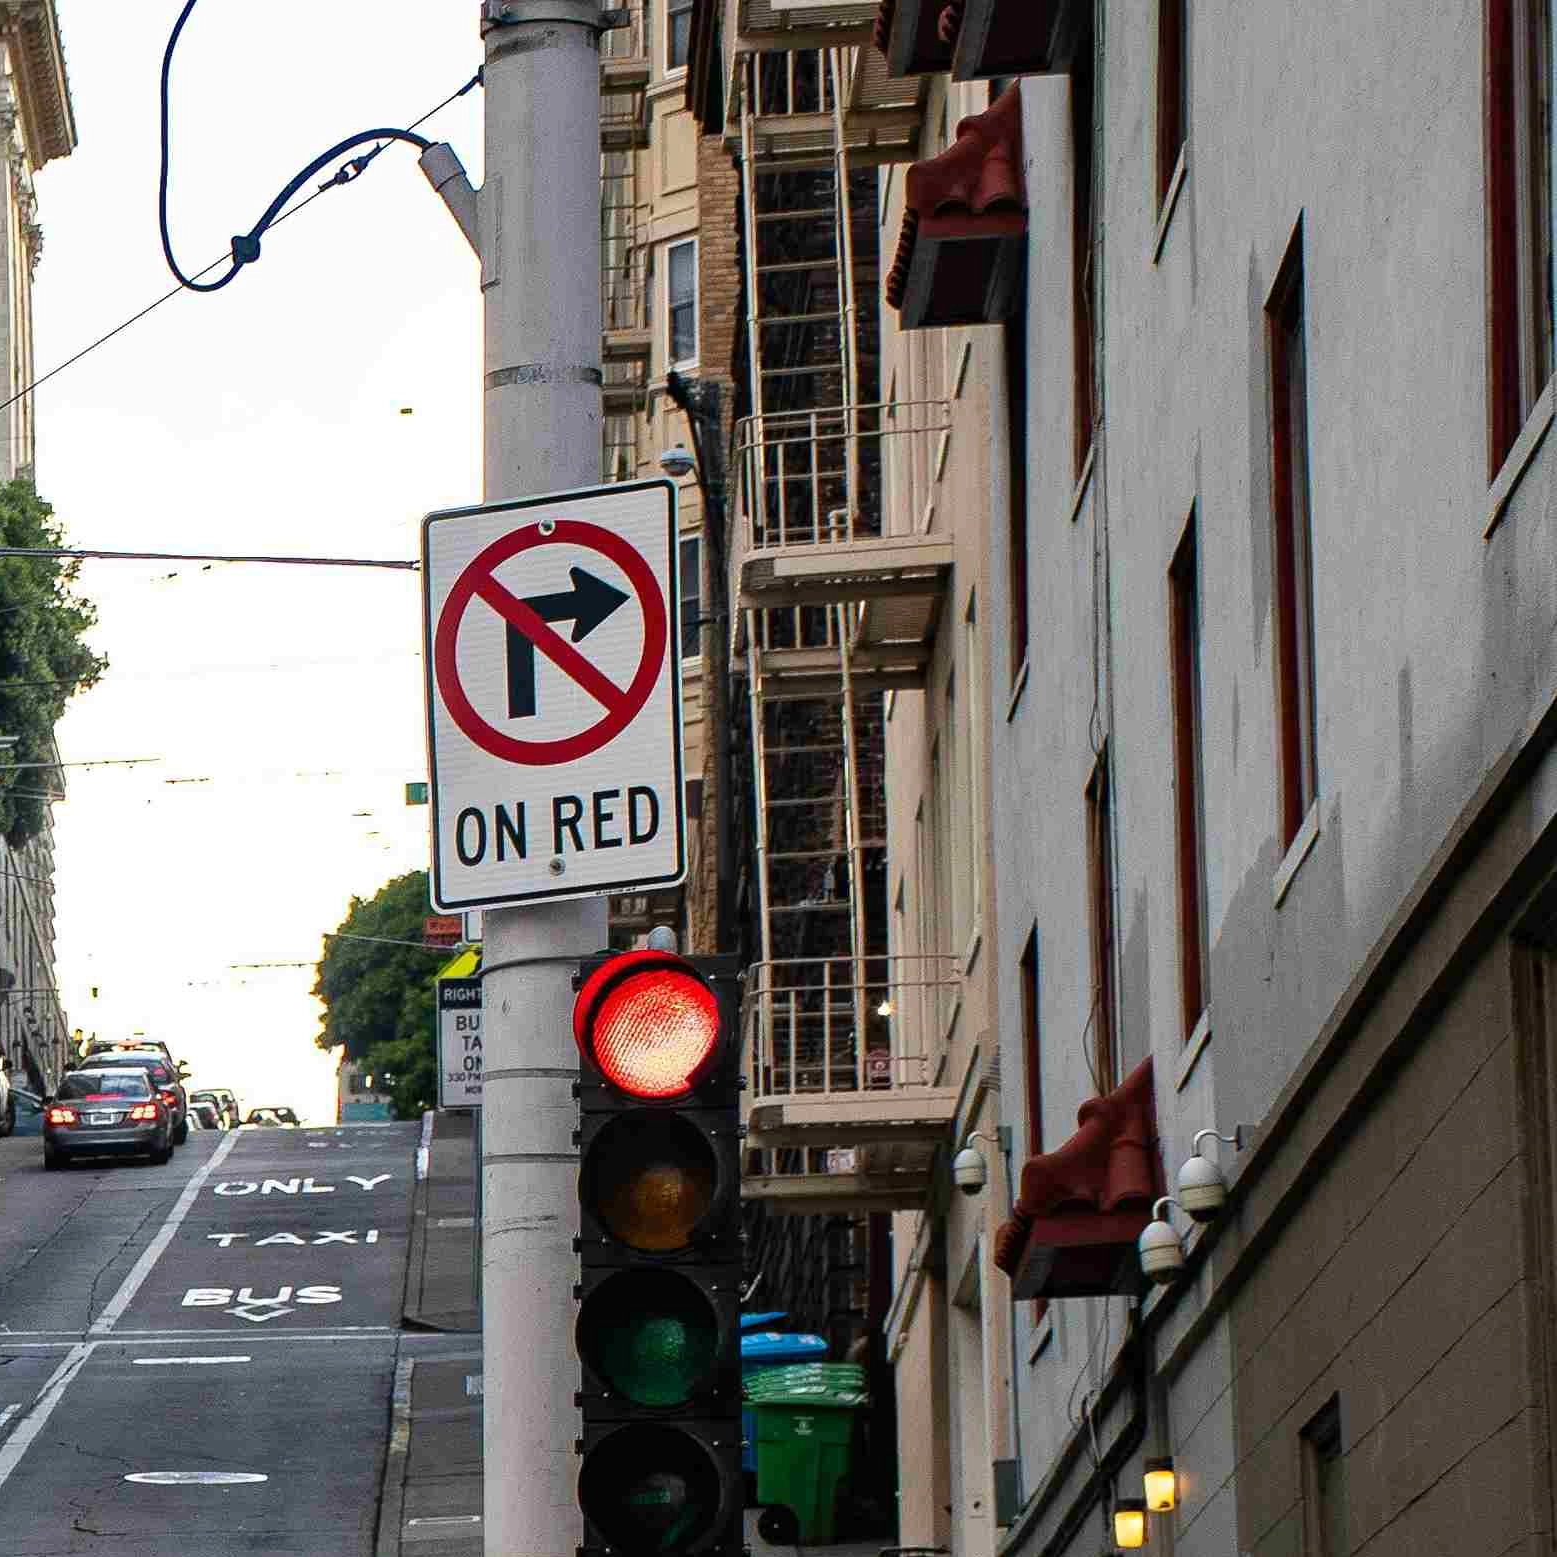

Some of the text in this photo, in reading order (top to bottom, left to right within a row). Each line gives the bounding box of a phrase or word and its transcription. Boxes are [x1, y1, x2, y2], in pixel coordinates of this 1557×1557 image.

[455, 784, 660, 867] ON RED
[456, 1015, 480, 1031] BU
[462, 1035, 483, 1051] TA
[463, 1055, 483, 1072] ON
[213, 1174, 392, 1196] ONLY
[207, 1229, 379, 1247] TAXI
[182, 1286, 343, 1306] BUS
